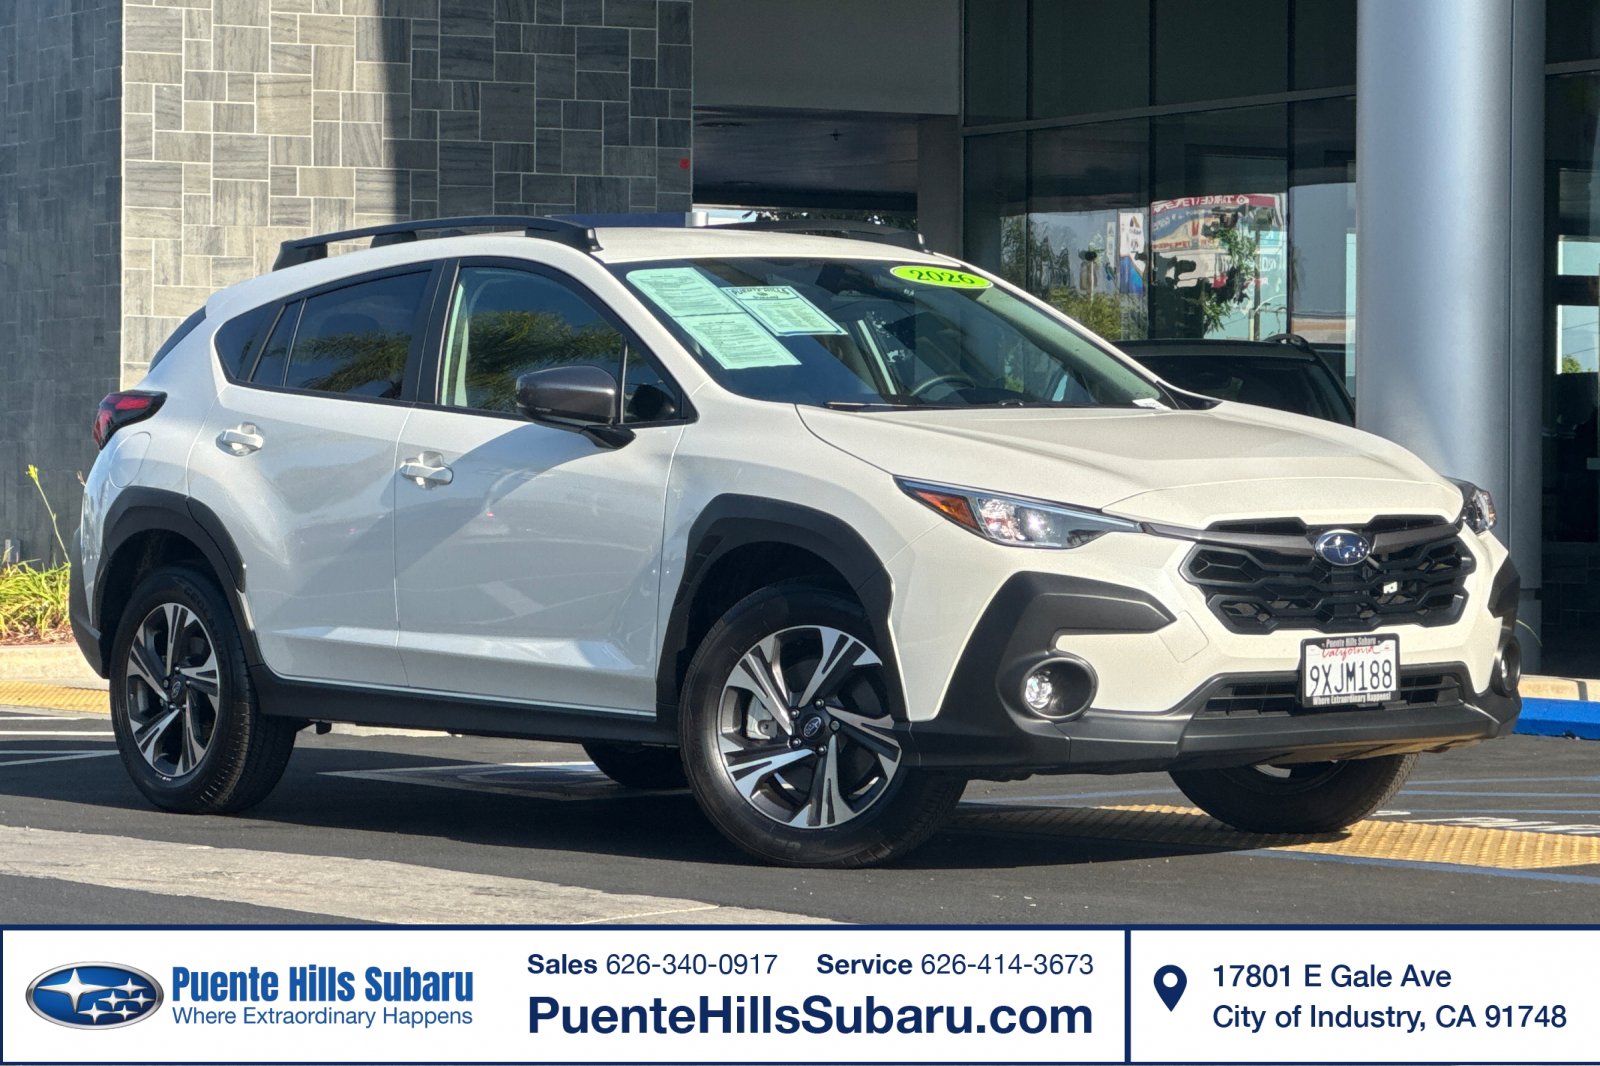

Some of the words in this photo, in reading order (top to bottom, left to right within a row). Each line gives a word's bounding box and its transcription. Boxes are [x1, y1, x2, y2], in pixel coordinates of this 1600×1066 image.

[909, 269, 975, 284] 2026
[1326, 639, 1345, 648] Puente
[1345, 638, 1357, 647] Hills
[1358, 637, 1377, 646] Subaru
[1321, 646, 1380, 661] California
[1309, 659, 1392, 696] 9XJM188
[1312, 696, 1330, 706] Where
[1331, 694, 1366, 705] Extraordinary
